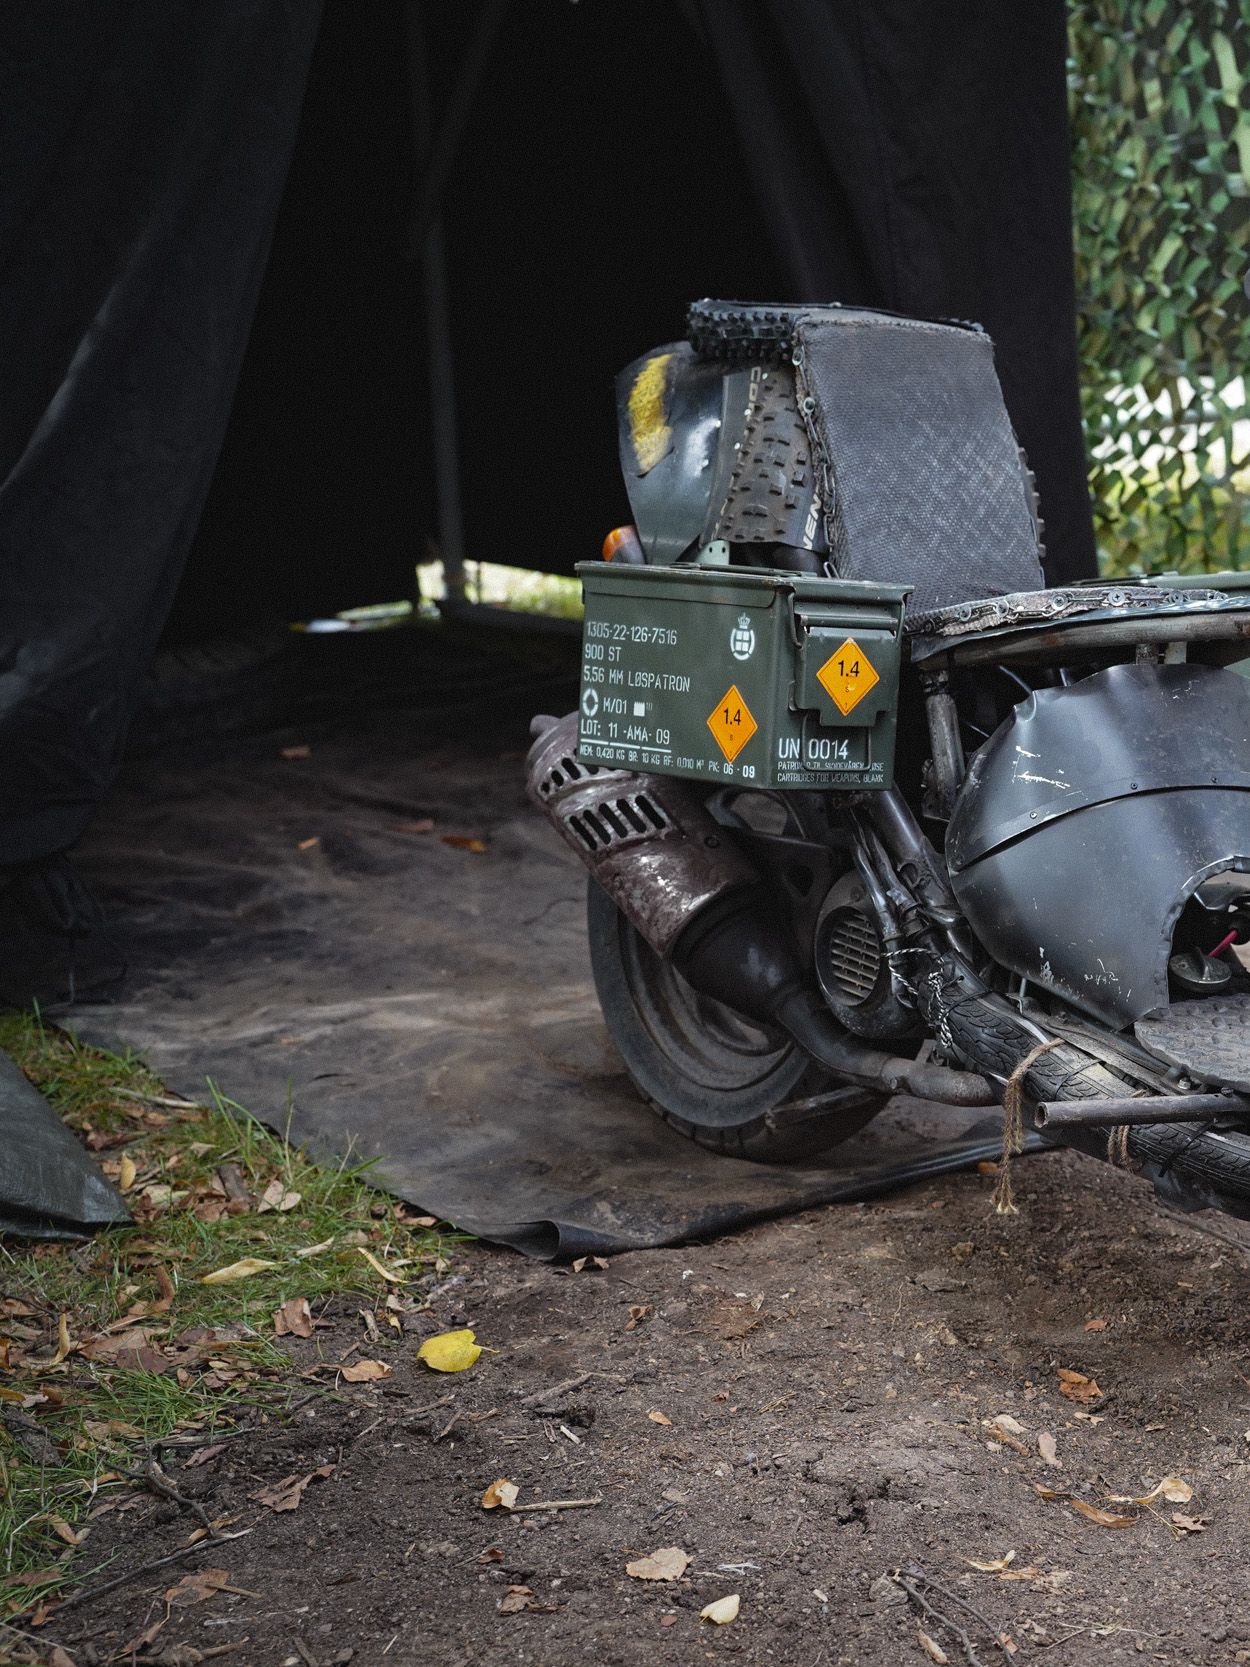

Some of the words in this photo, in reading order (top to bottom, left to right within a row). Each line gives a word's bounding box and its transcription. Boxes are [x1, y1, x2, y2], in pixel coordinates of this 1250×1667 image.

[586, 621, 678, 646] 1305-22-126-7516
[585, 643, 604, 660] 900
[608, 646, 622, 662] ST
[837, 660, 860, 677] 1.4
[608, 668, 624, 685] MM
[628, 670, 691, 693] LØSPATRON
[603, 697, 627, 715] M/01
[723, 708, 741, 726] 1.4
[580, 718, 601, 737] LOT:
[608, 722, 618, 739] 11
[656, 728, 670, 746] 09
[778, 738, 800, 759] UN
[808, 738, 849, 760] 0014
[615, 749, 625, 761] KG
[651, 753, 660, 765] KG
[723, 762, 734, 775] 06
[742, 765, 755, 779] 09
